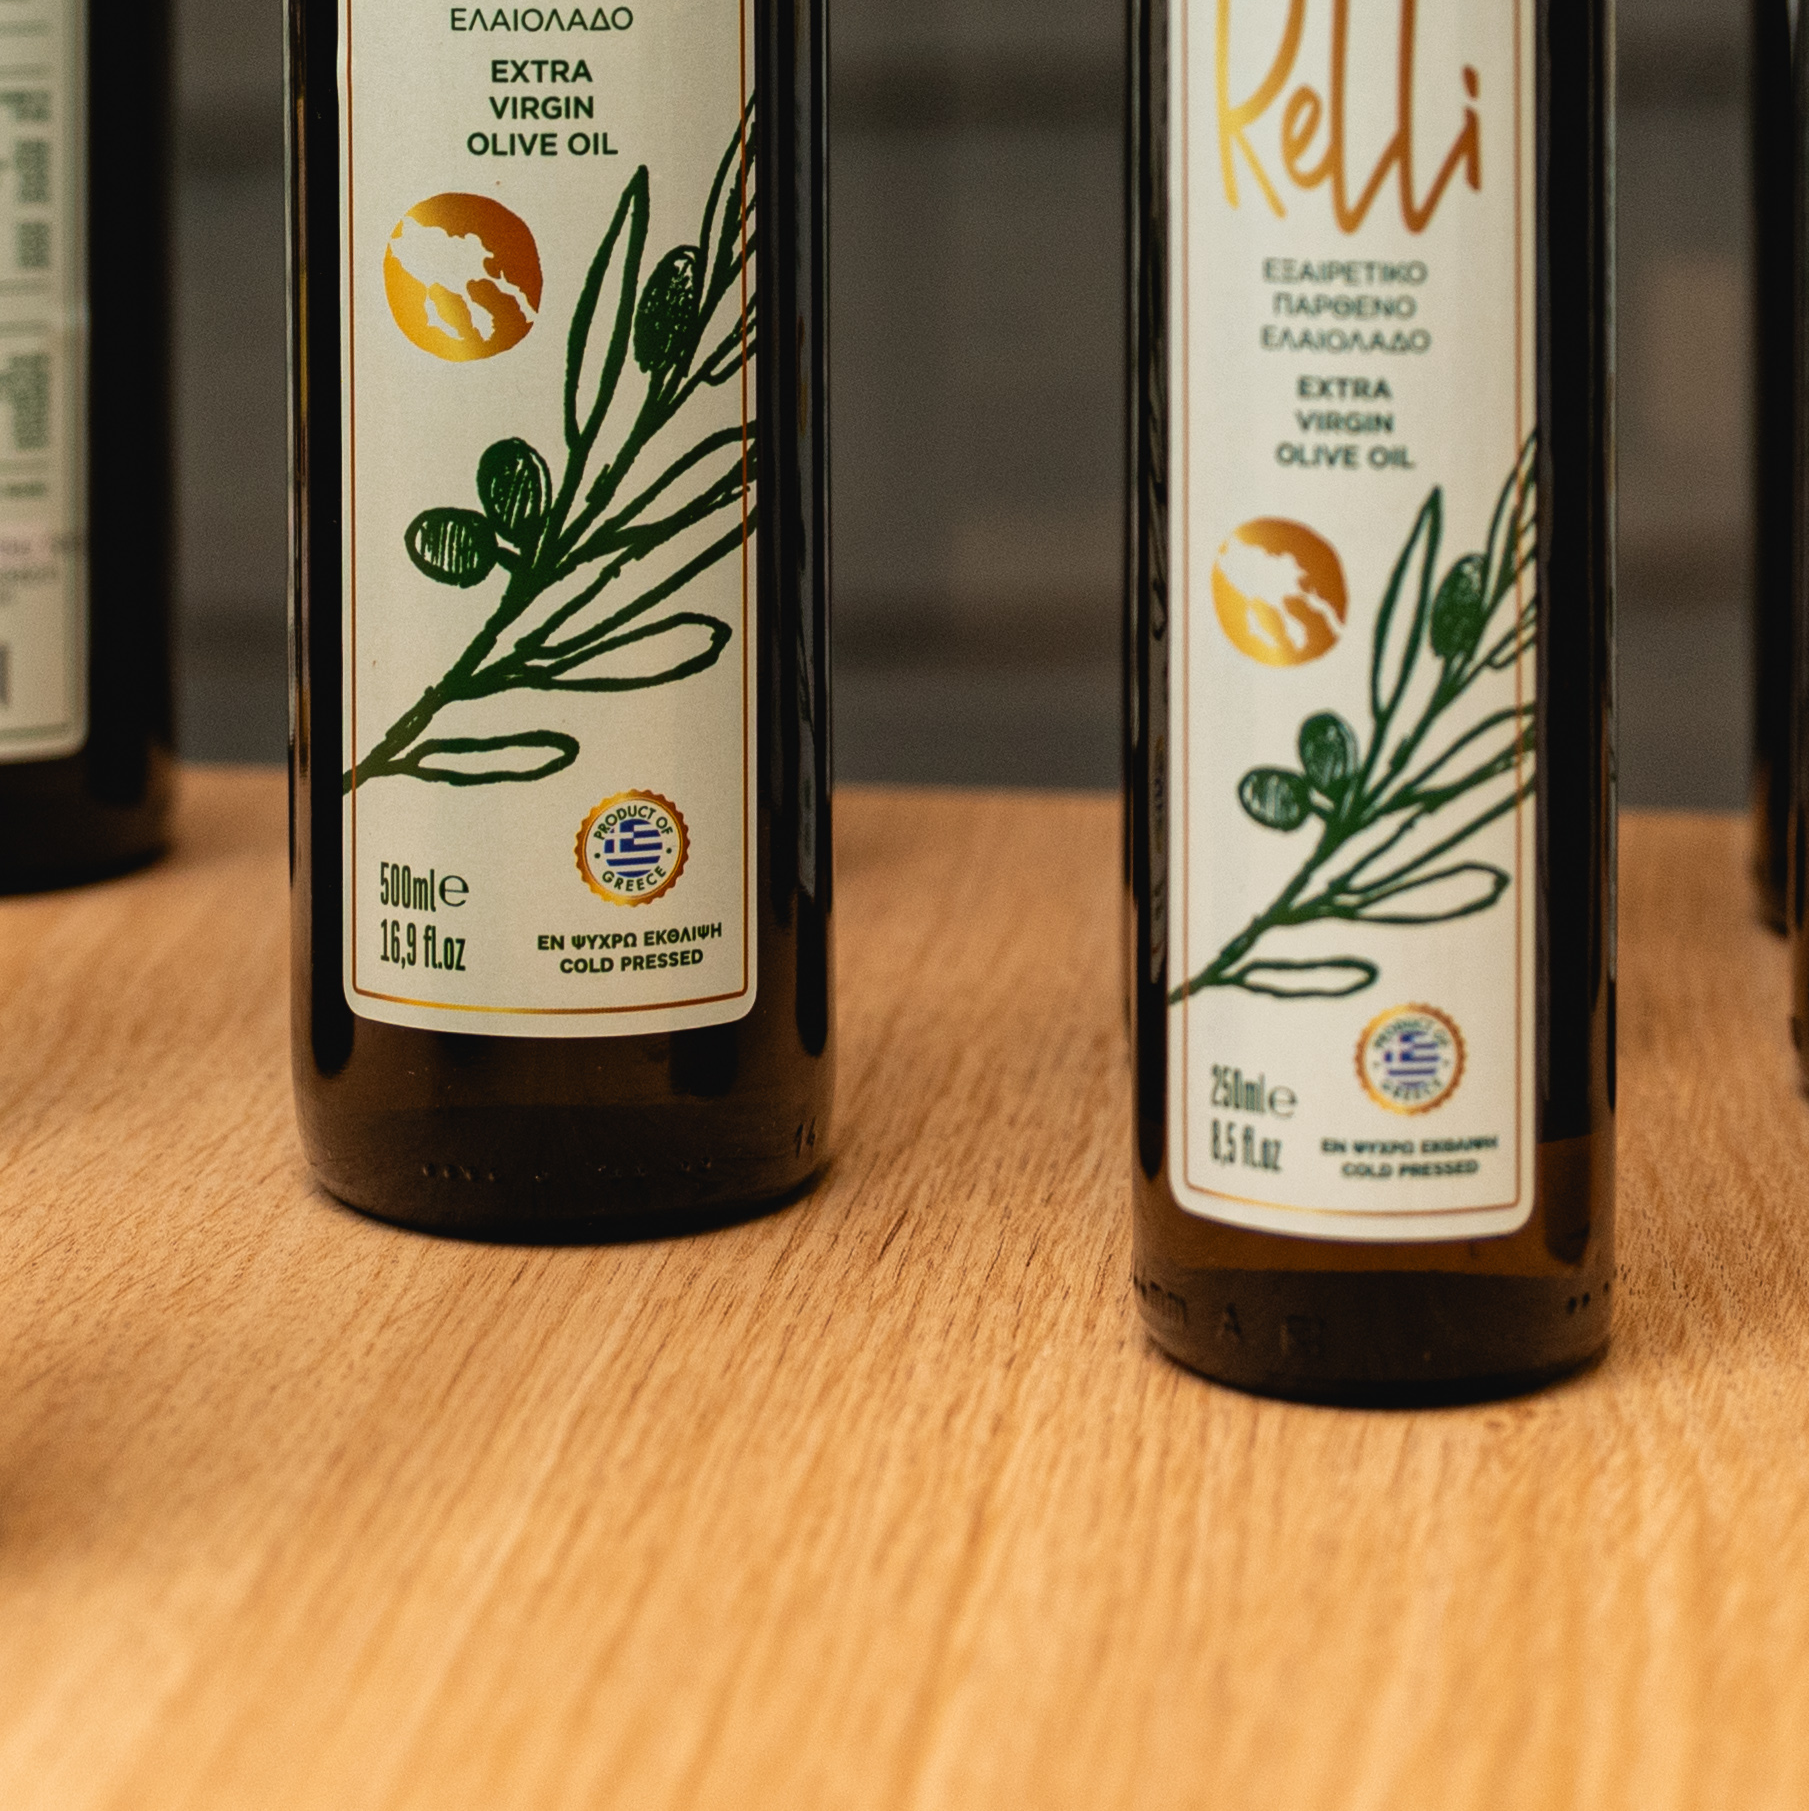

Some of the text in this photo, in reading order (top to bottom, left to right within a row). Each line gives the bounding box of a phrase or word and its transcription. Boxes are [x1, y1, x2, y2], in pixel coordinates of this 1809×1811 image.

[450, 7, 633, 31] ΕΛΑΙΟΛΑΔΟ
[491, 60, 592, 83] EXTRA
[489, 96, 594, 119] VIRGIN
[466, 132, 618, 157] OLIVE OIL
[1297, 375, 1392, 400] EXTRA
[1295, 409, 1394, 435] VIRGIN
[1275, 441, 1416, 470] OLIVE OIL
[593, 805, 673, 841] PRODUCT OF
[601, 865, 667, 892] GREECE
[380, 919, 466, 972] 16,9 fl.oz
[571, 932, 637, 951] ΨΥΧΡΩ
[643, 922, 722, 947] ΕΚΘΛΙΨΗ
[560, 948, 703, 974] COLD PRESSED
